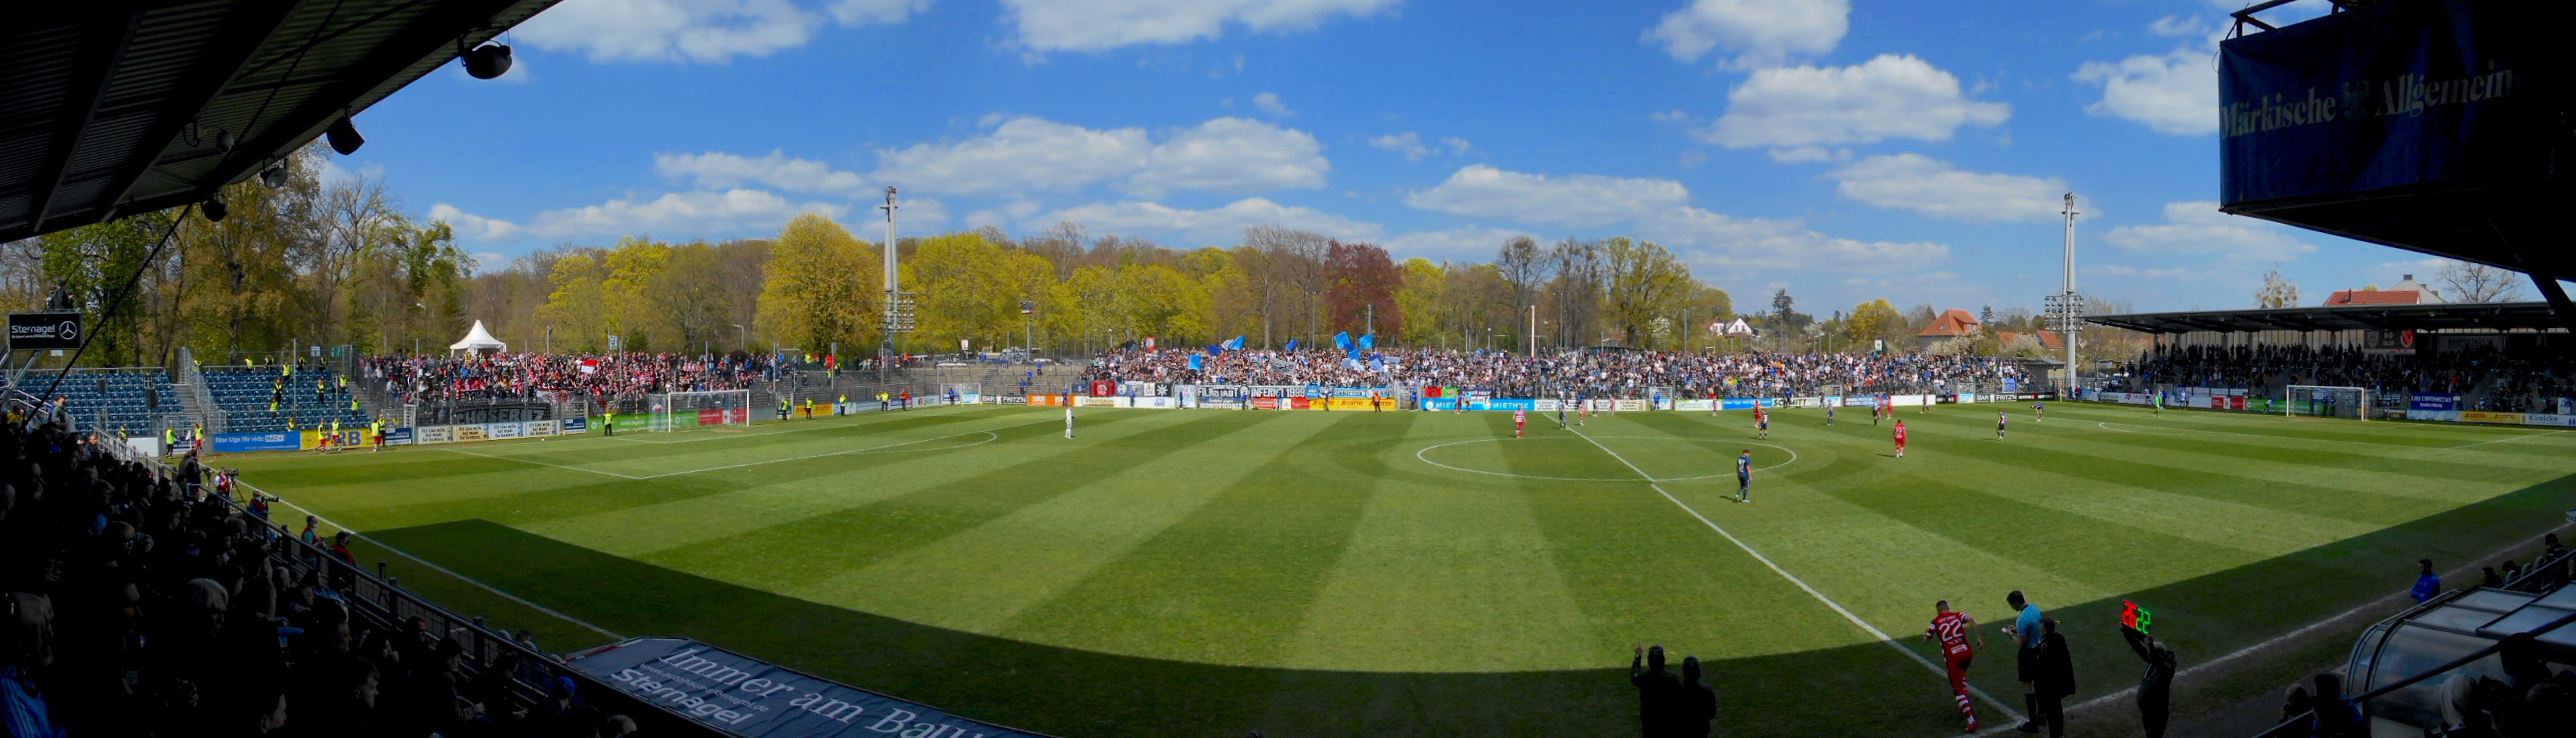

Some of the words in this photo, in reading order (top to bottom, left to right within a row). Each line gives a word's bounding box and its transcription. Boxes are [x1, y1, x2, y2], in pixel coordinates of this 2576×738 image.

[2221, 86, 2337, 139] Märkische
[11, 324, 56, 335] Sternagel
[1286, 387, 1306, 398] 1999
[1939, 619, 1965, 642] 22
[2136, 606, 2152, 635] 22
[610, 668, 755, 725] Sternagel
[658, 647, 794, 699] Immer
[789, 691, 864, 724] am
[865, 707, 984, 738] Ball
